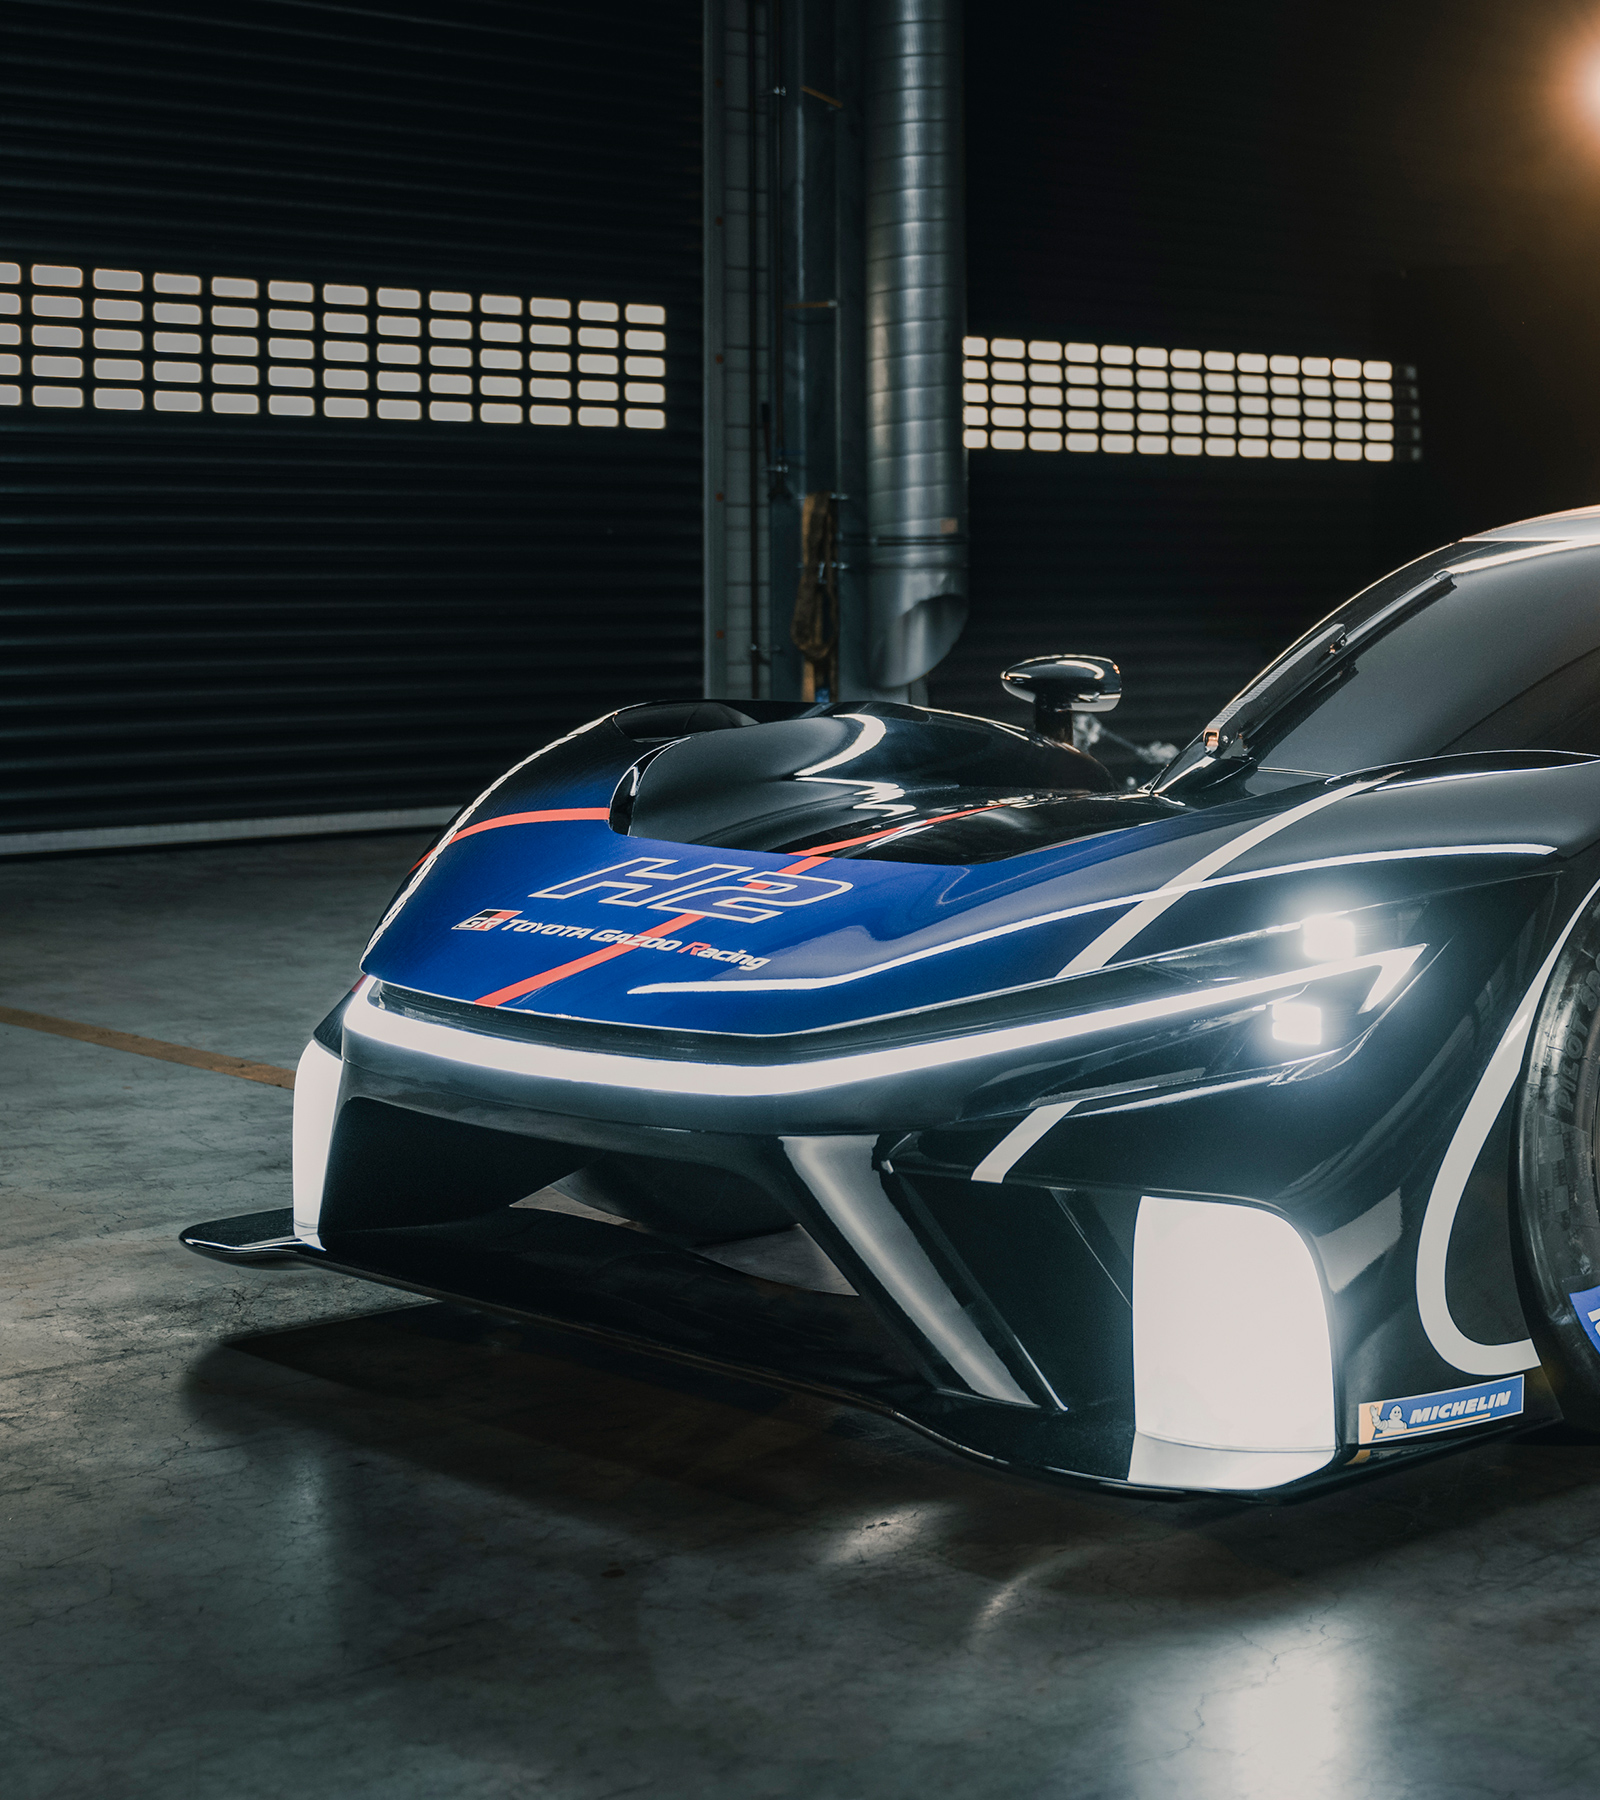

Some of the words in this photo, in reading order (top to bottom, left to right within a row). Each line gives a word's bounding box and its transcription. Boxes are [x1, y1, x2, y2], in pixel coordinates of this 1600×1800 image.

[528, 857, 854, 924] H2
[458, 916, 505, 929] GR
[502, 919, 595, 939] TOYOTA
[590, 929, 683, 951] GAZOO
[677, 941, 771, 971] Racing
[1409, 1391, 1511, 1424] MICHELIN
